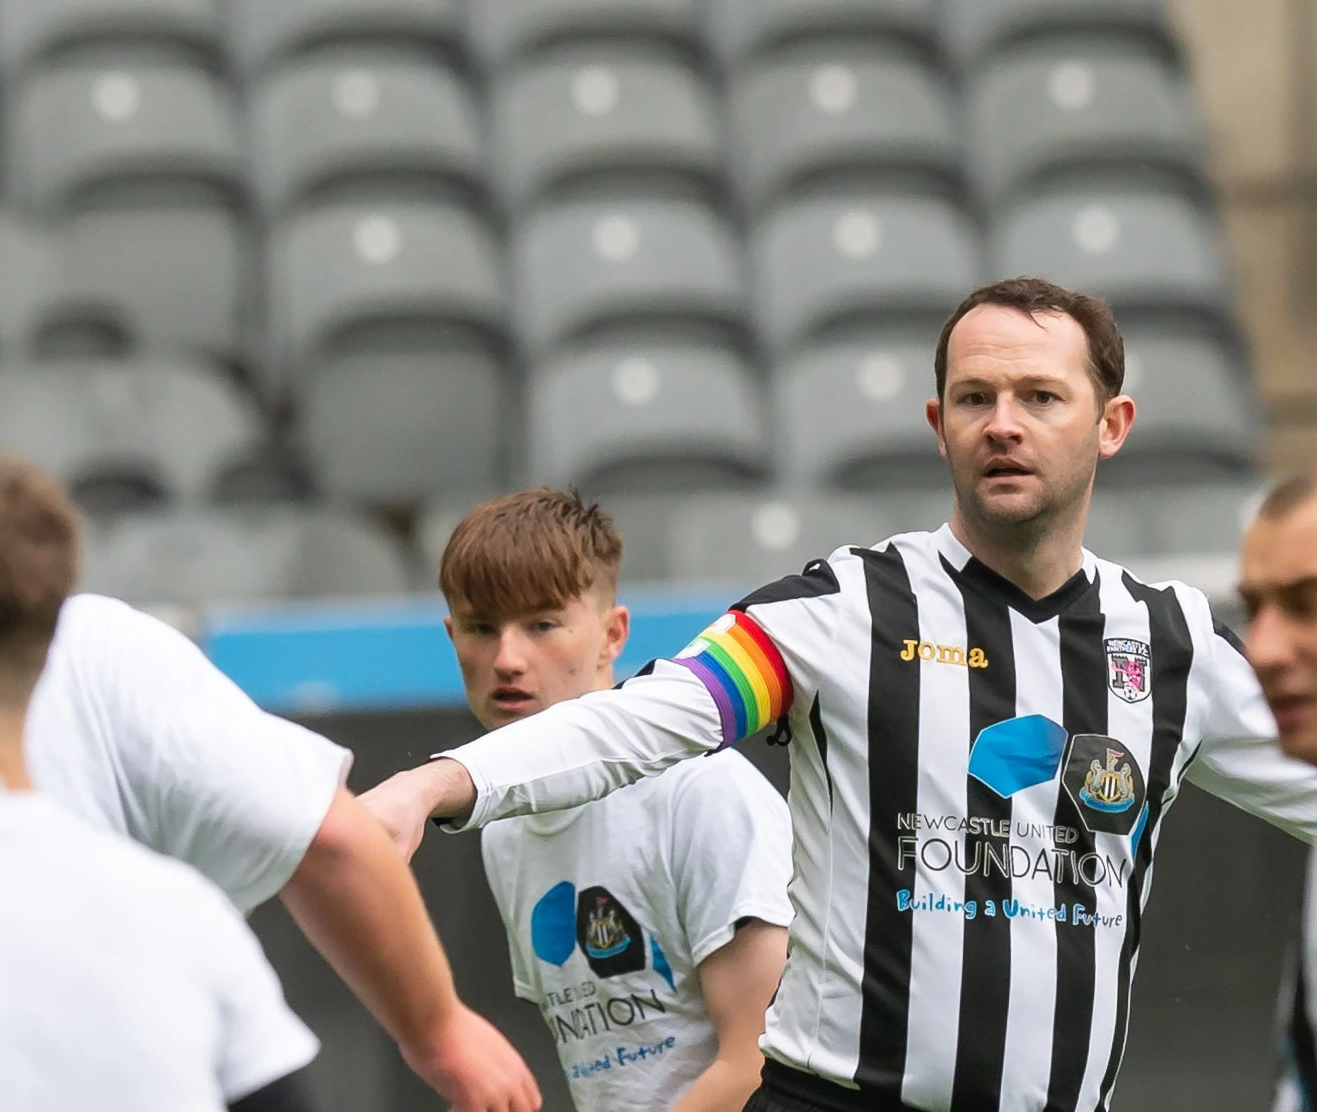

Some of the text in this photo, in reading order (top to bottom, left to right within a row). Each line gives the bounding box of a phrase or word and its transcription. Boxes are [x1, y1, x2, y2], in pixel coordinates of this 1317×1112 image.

[899, 639, 989, 669] Joma
[897, 813, 1080, 844] NEWCASTLE UNITED
[897, 835, 1128, 888] FOUNDATION
[896, 888, 1123, 927] Building a United Future
